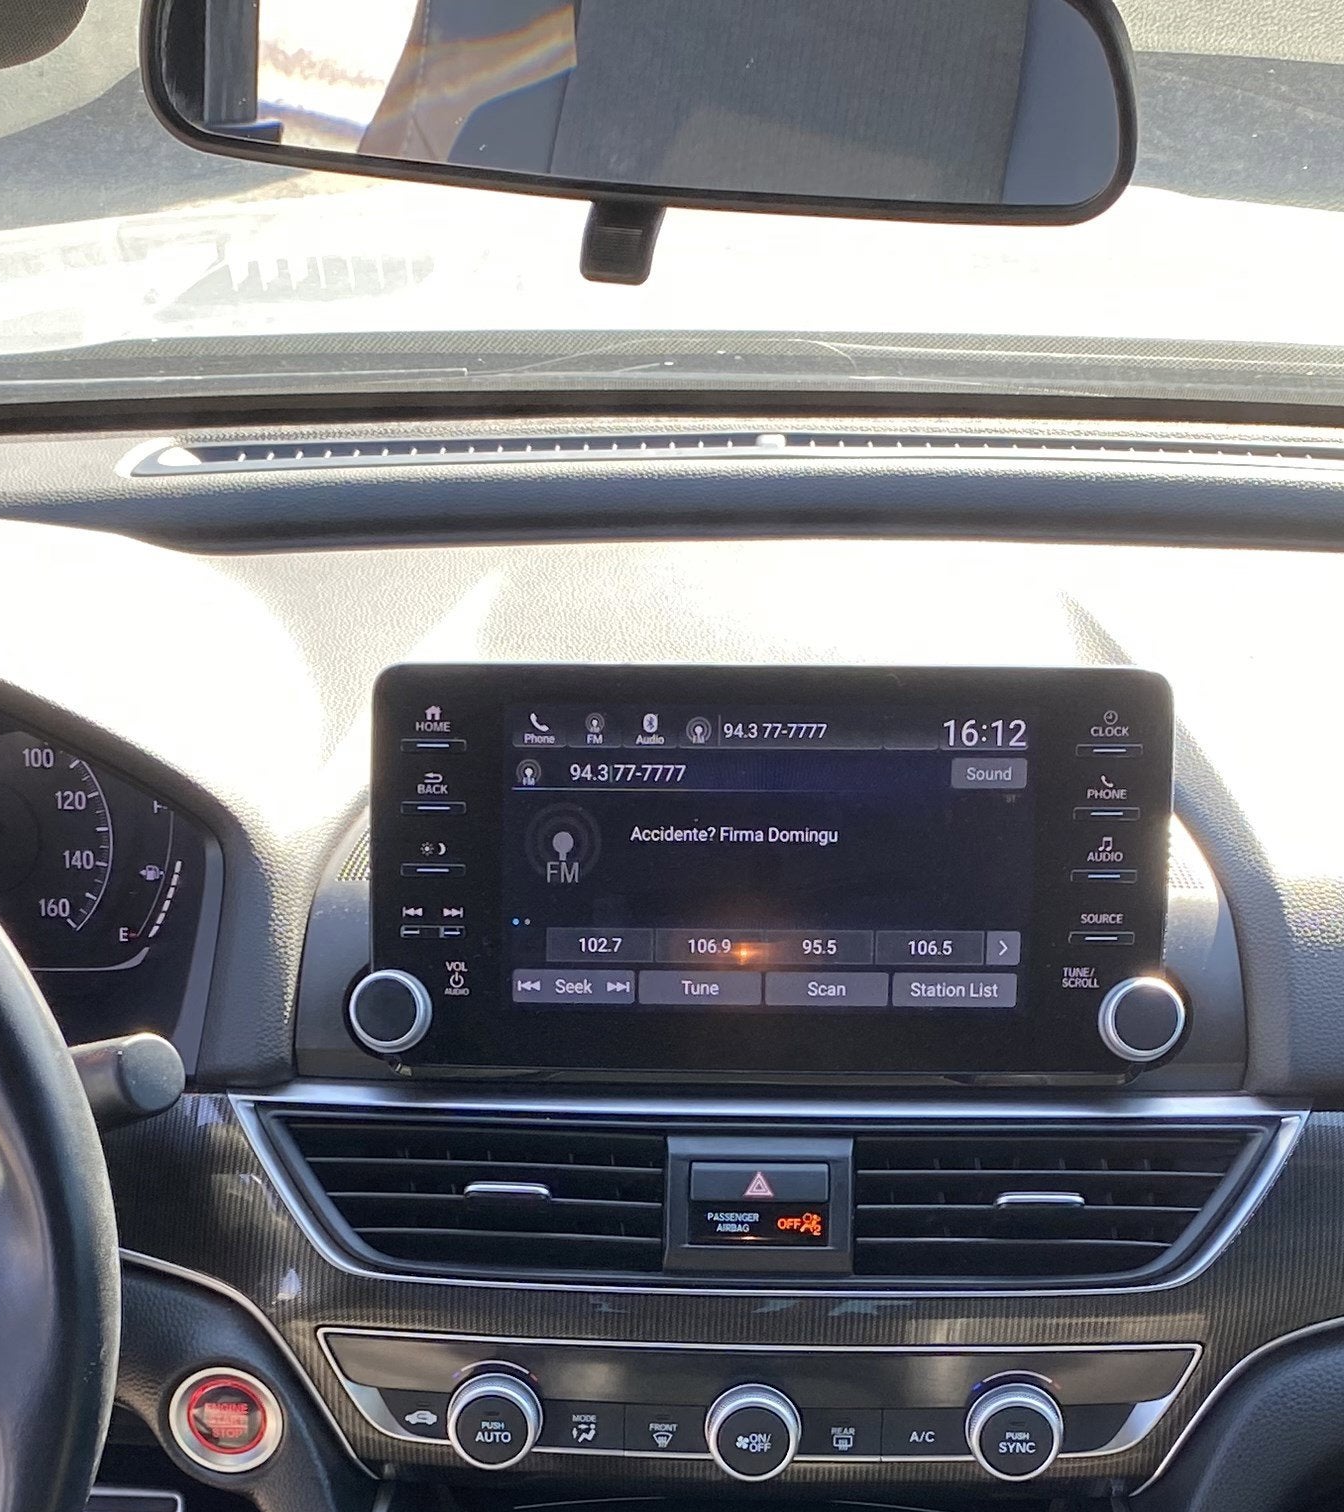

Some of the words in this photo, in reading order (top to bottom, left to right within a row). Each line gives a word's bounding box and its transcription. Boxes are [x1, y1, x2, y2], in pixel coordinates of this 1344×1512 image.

[415, 722, 451, 732] HOME
[723, 723, 758, 739] 94.3
[762, 723, 828, 740] 77-7777
[943, 719, 1027, 746] 16:12
[1090, 727, 1129, 737] CLOCK
[524, 734, 555, 745] Phone
[586, 735, 603, 744] FM
[636, 735, 664, 746] Audio
[23, 748, 54, 768] 100
[570, 764, 608, 782] 94.3
[614, 764, 686, 782] 77-7777
[966, 767, 1012, 782] Sound
[417, 784, 448, 795] BACK
[1087, 789, 1128, 800] PHONE
[55, 791, 86, 810] 120
[630, 827, 715, 842] Accidente?
[720, 828, 764, 842] Firma
[768, 828, 838, 846] Domingu
[63, 850, 94, 870] 140
[1087, 852, 1124, 862] AUDIO
[546, 862, 579, 884] FM
[39, 899, 70, 918] 160
[1081, 914, 1124, 924] SOURCE
[119, 927, 128, 942] E
[579, 938, 622, 953] 102.7
[688, 939, 732, 954] 106.9
[802, 940, 837, 955] 95.5
[908, 940, 952, 956] 106.5
[446, 962, 468, 972] VOL
[1063, 967, 1095, 978] TUNE/
[556, 979, 592, 994] Seek
[682, 981, 719, 996] Tune
[808, 982, 846, 996] Scan
[1062, 978, 1100, 988] SCROLL
[444, 987, 470, 996] AUDIO
[910, 982, 965, 998] Station
[970, 982, 998, 998] List
[707, 1212, 759, 1222] PASSENGER
[716, 1224, 750, 1232] AIRBAG
[777, 1218, 802, 1230] OFF
[572, 1414, 597, 1422] MODE
[482, 1422, 504, 1430] PUSH
[649, 1423, 678, 1432] FRONT
[831, 1428, 856, 1436] REAR
[475, 1431, 512, 1444] AUTO
[749, 1433, 772, 1444] ON/
[909, 1431, 935, 1443] A/C
[1006, 1432, 1029, 1440] PUSH
[749, 1443, 771, 1453] OFF
[998, 1442, 1036, 1454] SYNC
